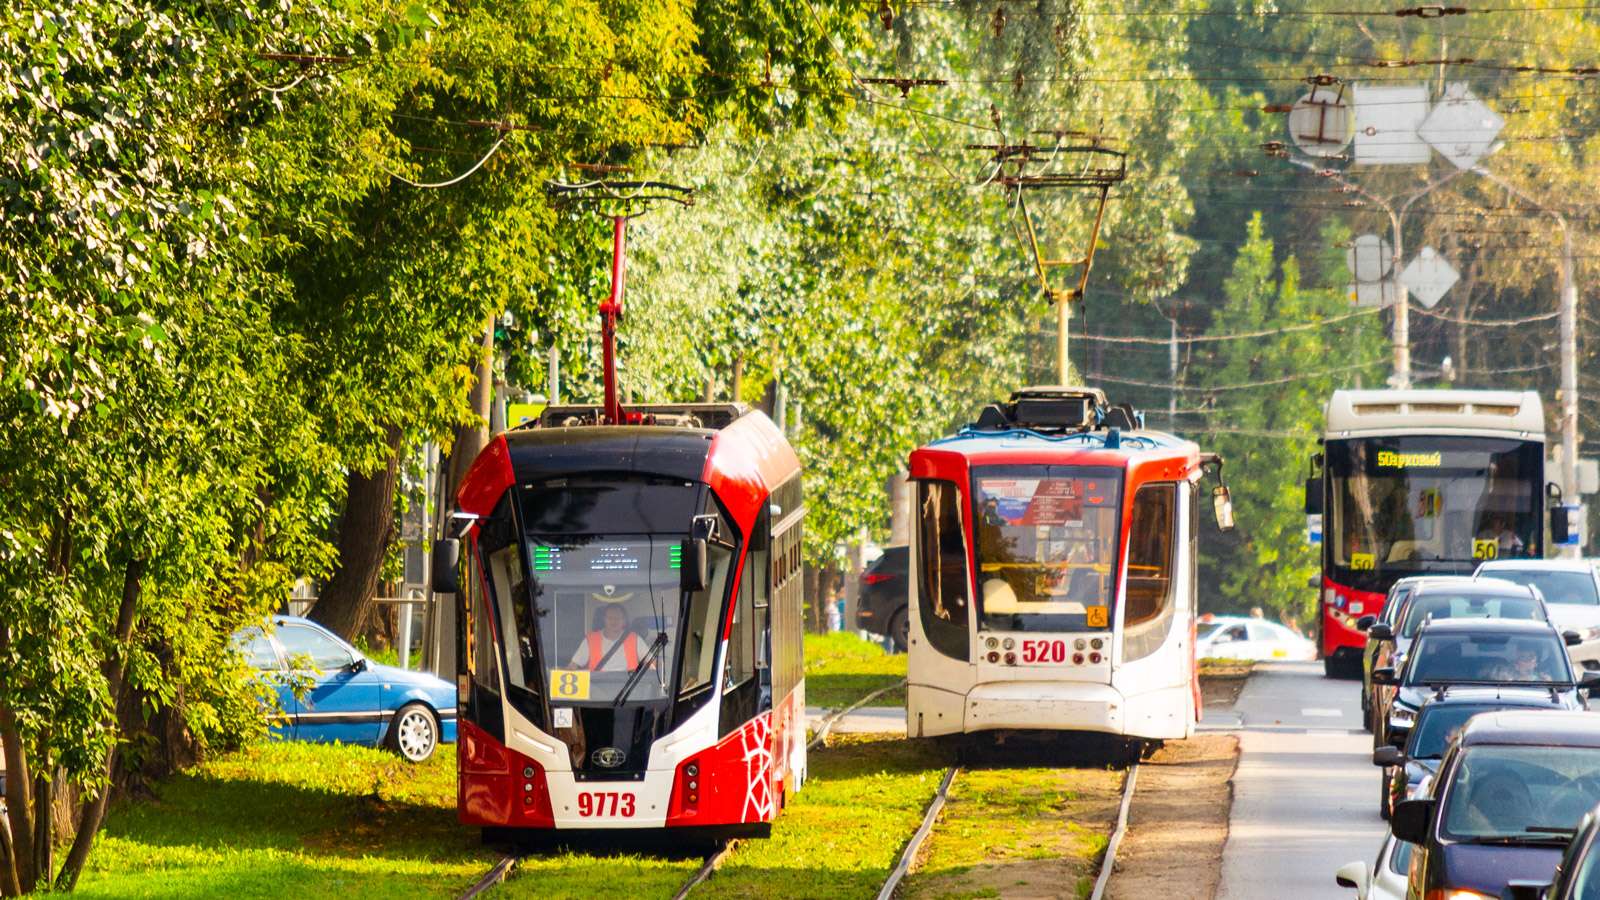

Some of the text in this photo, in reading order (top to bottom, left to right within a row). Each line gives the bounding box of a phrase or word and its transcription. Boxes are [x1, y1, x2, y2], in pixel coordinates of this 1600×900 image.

[1475, 542, 1496, 559] 50
[1354, 559, 1372, 570] 50
[1022, 640, 1065, 663] 520
[558, 673, 579, 696] 8
[578, 792, 636, 818] 9773
